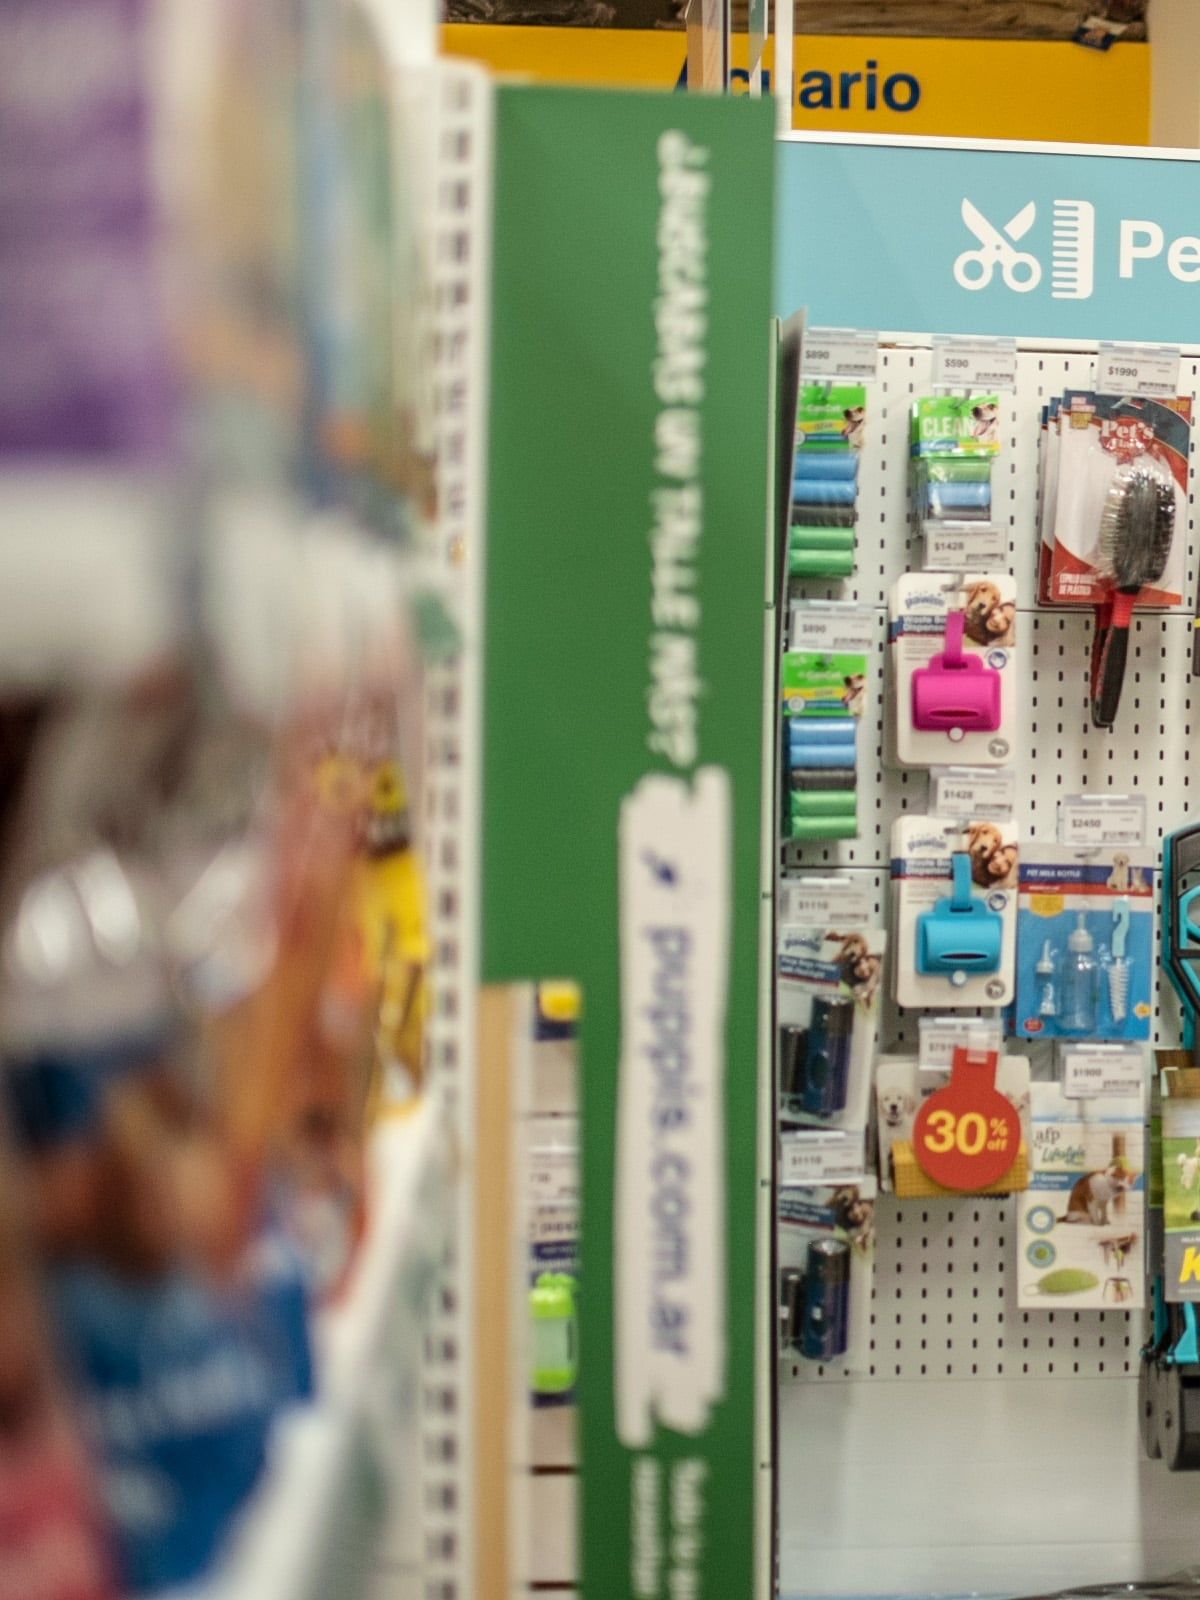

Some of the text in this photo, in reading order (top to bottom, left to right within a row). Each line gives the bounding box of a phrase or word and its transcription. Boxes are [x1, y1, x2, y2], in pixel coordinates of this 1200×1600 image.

[674, 59, 922, 113] cario
[944, 357, 970, 369] $590
[1107, 366, 1138, 378] $1990
[1102, 419, 1156, 440] Pet's
[644, 923, 700, 1358] puppis.com.ar
[986, 1138, 1008, 1152] off
